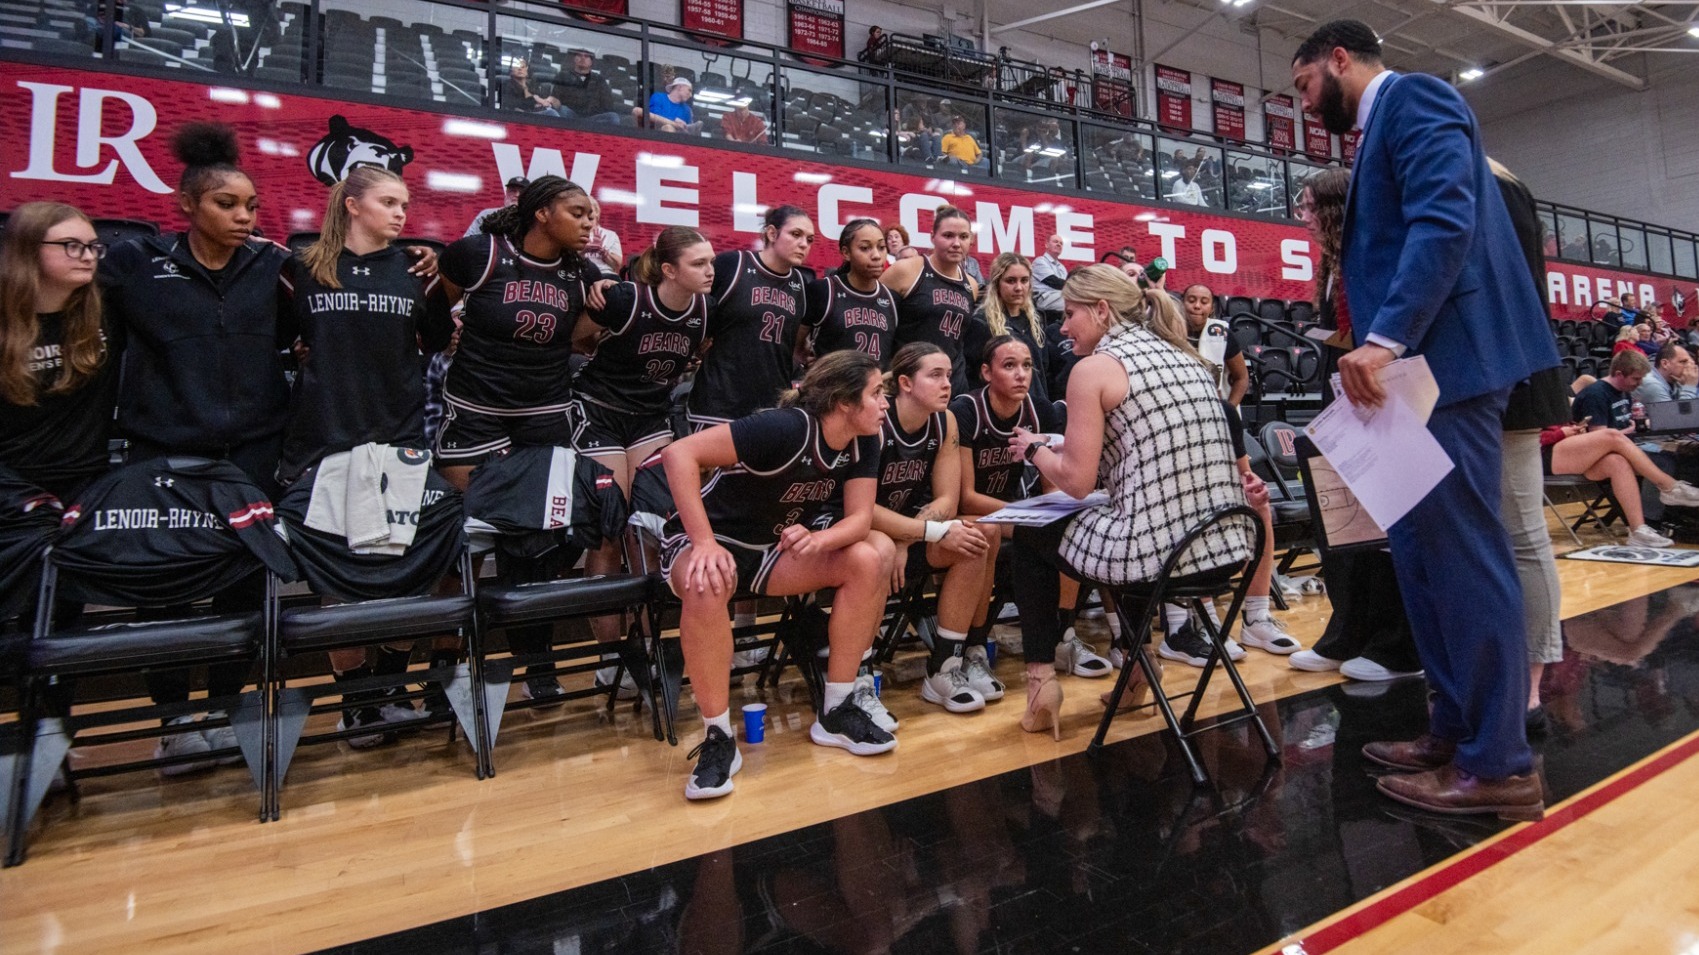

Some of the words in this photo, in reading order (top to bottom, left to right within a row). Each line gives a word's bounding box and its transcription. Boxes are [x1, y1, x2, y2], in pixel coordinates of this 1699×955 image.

[9, 80, 174, 194] LR
[1309, 127, 1327, 137] NCAA
[491, 141, 1095, 262] WELCOME
[1148, 221, 1238, 275] TO
[1546, 271, 1656, 309] ARENA
[308, 293, 414, 317] LENOIR-RHYNE
[503, 279, 569, 312] BEARS
[751, 286, 796, 315] BEARS
[933, 288, 970, 314] BEARS
[513, 310, 557, 345] 23
[759, 311, 785, 345] 21
[844, 307, 889, 331] BEARS
[939, 310, 964, 340] 44
[637, 332, 691, 357] BEARS
[855, 331, 881, 361] 24
[640, 359, 676, 385] 32
[978, 447, 1013, 468] BEA
[779, 479, 836, 502] BEAS
[986, 469, 1010, 494] 11
[94, 507, 224, 531] LENOIR-RHYNE
[550, 496, 567, 528] BEA
